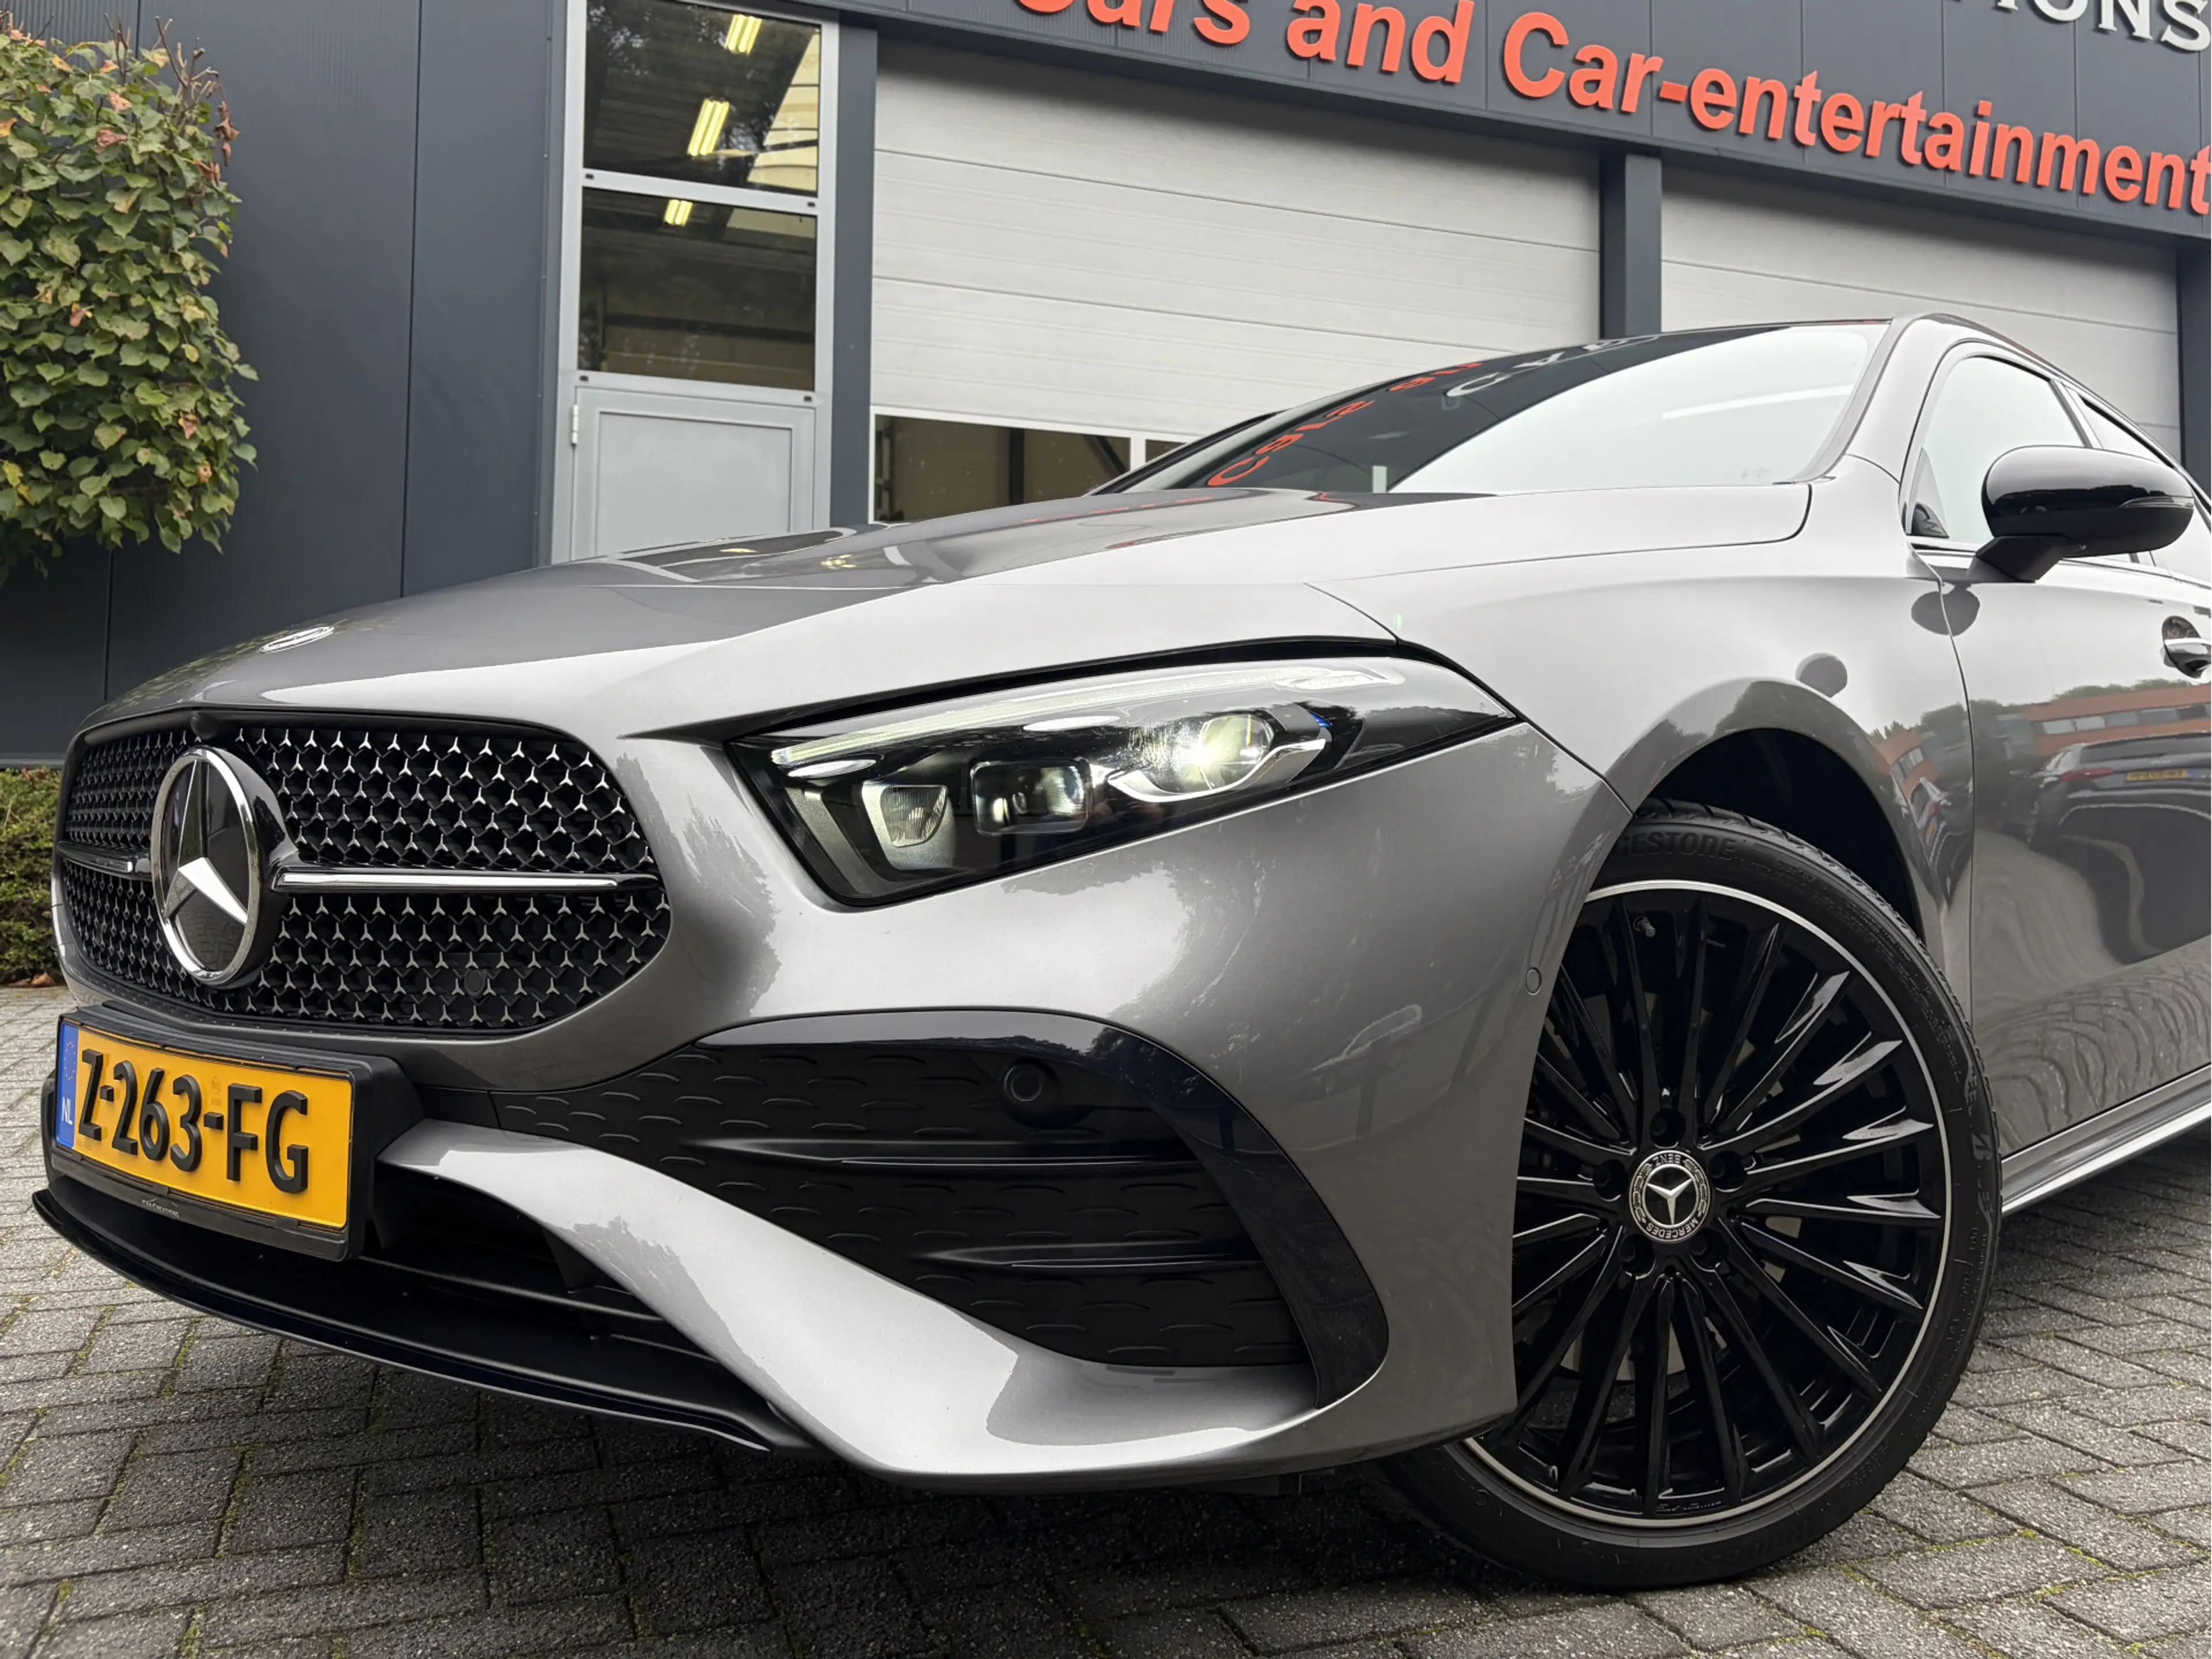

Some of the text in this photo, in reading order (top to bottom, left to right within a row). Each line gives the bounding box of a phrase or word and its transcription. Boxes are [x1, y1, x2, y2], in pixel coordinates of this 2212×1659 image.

[1287, 0, 1474, 83] and
[1504, 12, 2211, 214] Car-entertainment
[62, 1097, 73, 1125] NL
[78, 1048, 309, 1195] Z-263-FG
[1653, 1153, 1682, 1165] BENZ
[1646, 1217, 1700, 1239] MERCEDES
